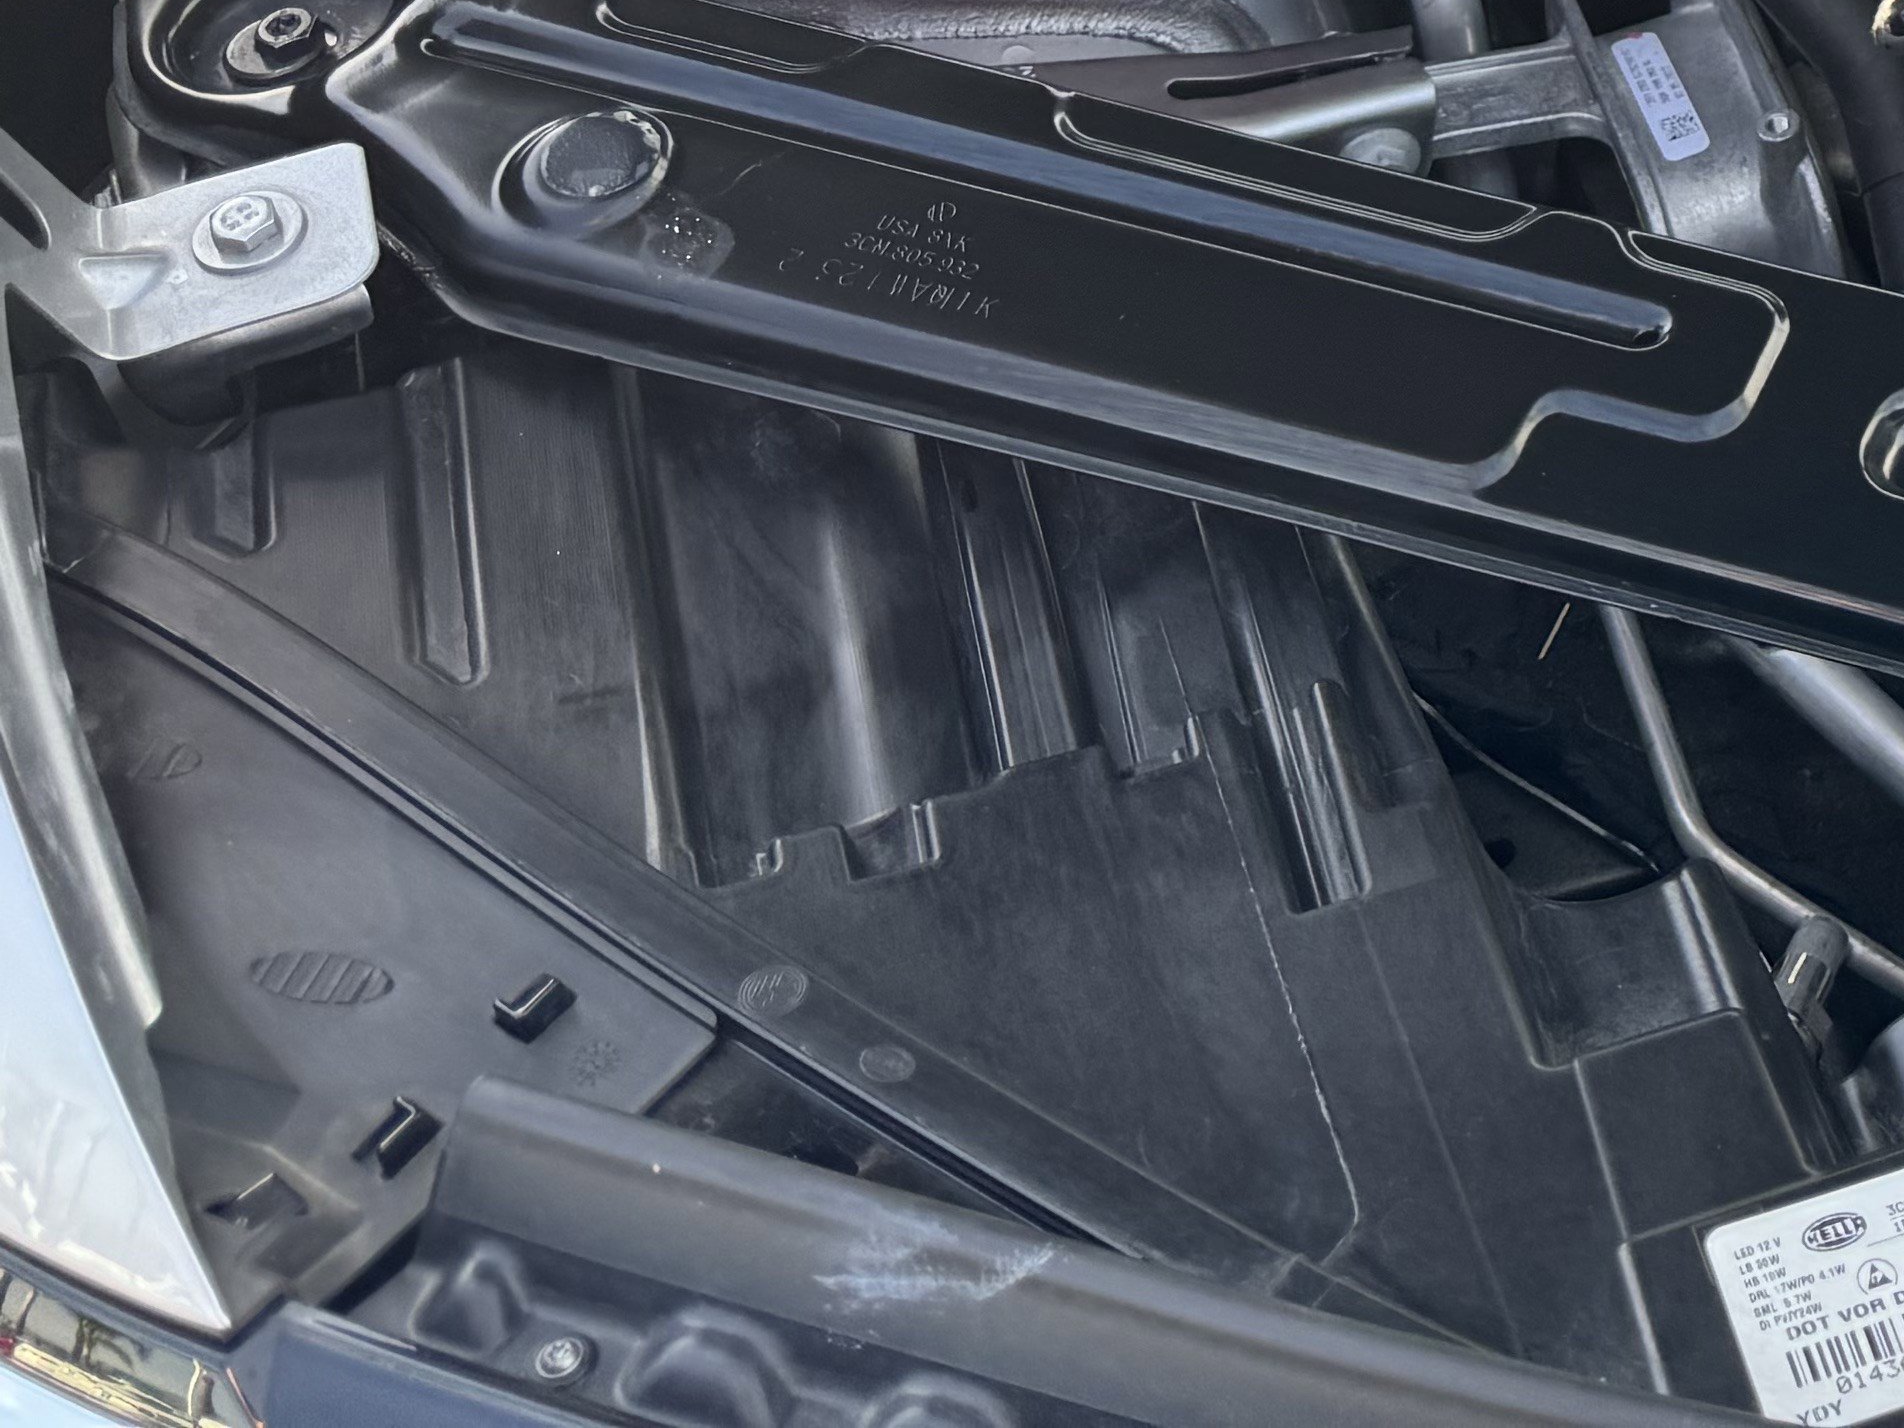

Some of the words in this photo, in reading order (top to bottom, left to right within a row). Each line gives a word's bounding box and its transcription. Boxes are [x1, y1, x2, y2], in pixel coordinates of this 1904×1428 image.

[1806, 1216, 1867, 1249] HELLA
[1733, 1245, 1754, 1260] LED
[1757, 1239, 1770, 1252] 12
[1772, 1236, 1780, 1247] V
[1786, 1315, 1828, 1340] DOT
[1837, 1298, 1886, 1322] VOR
[1797, 1399, 1843, 1426] YDY
